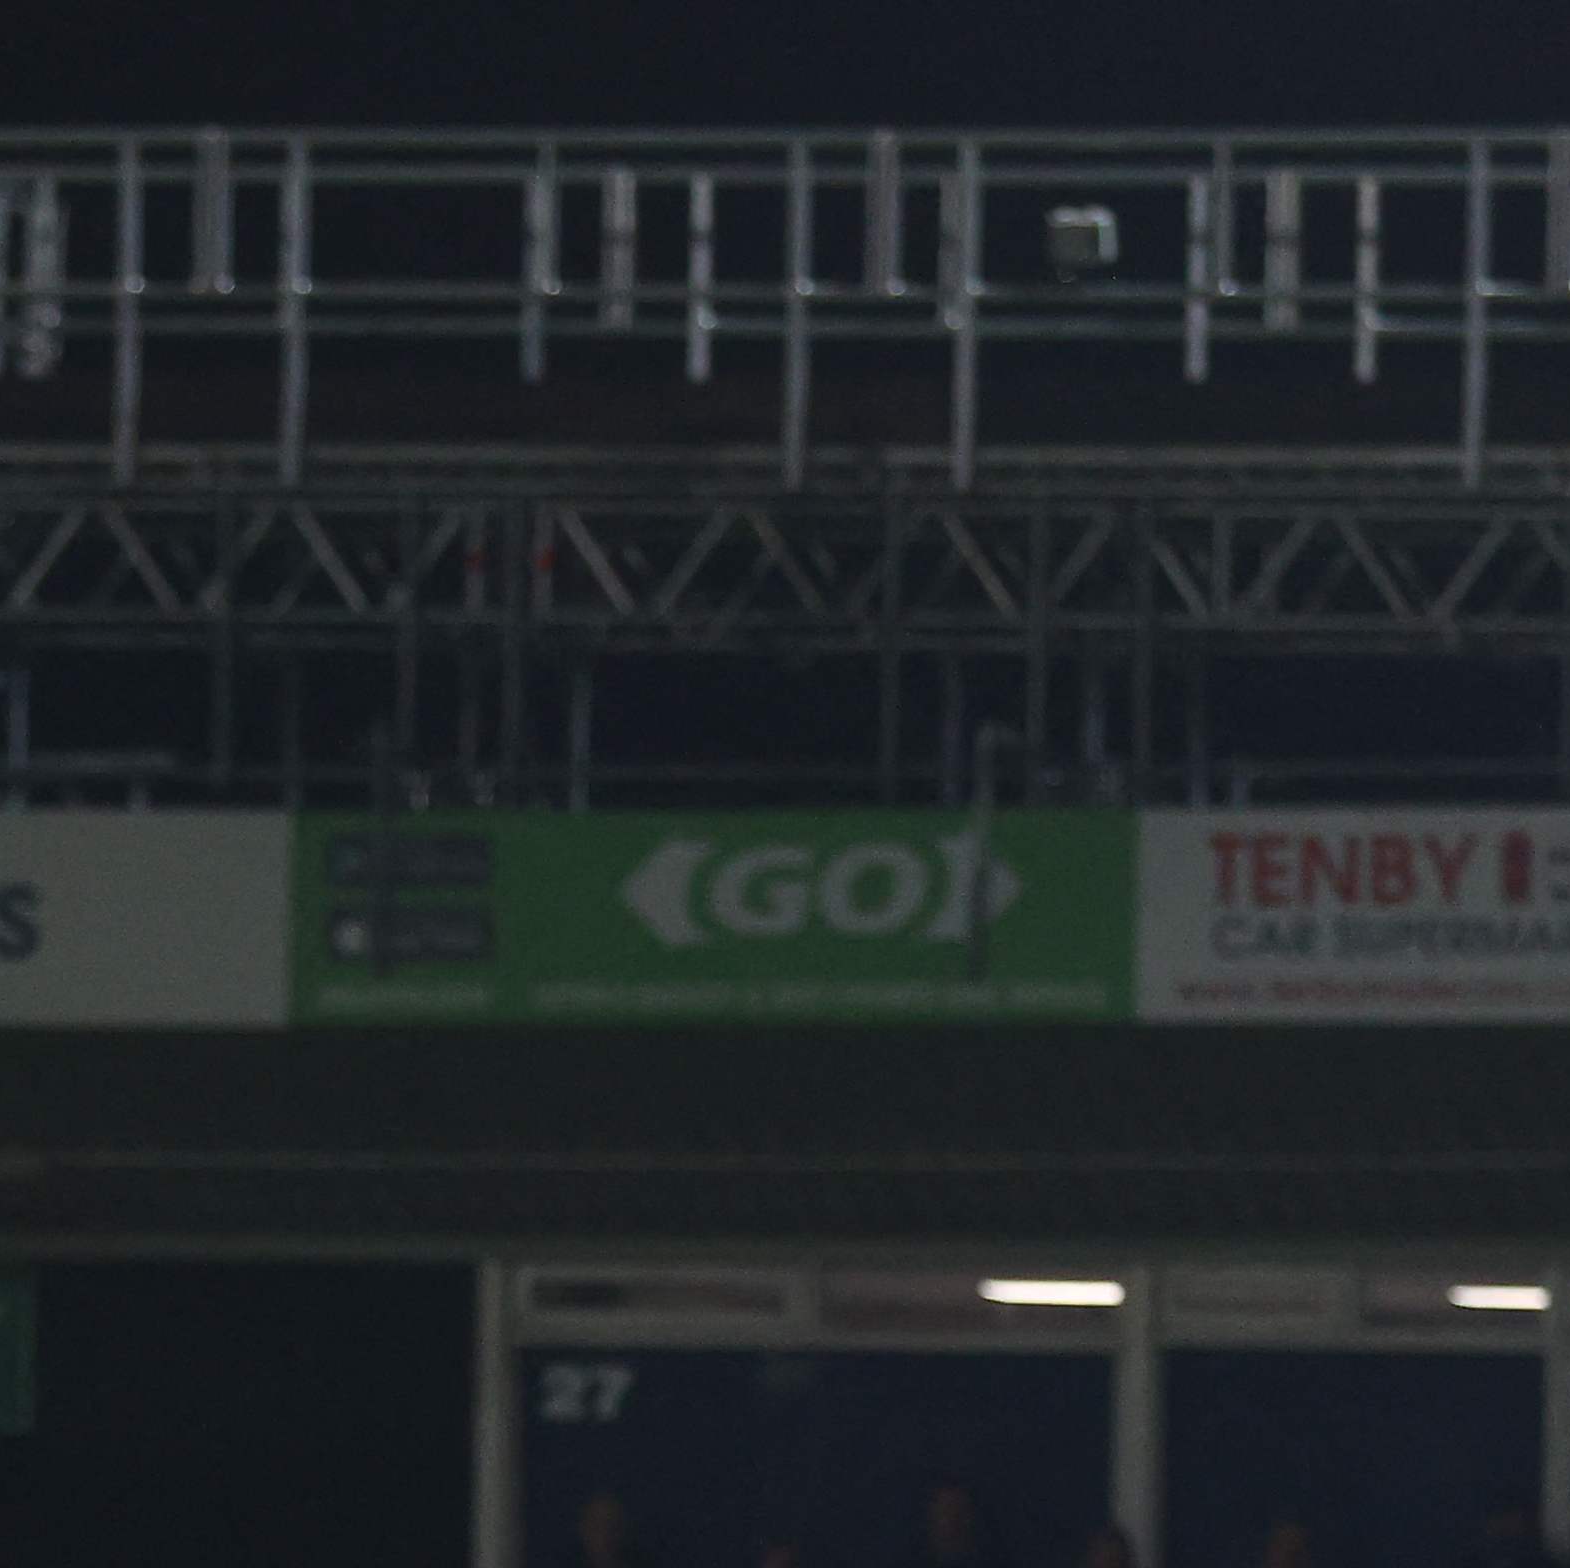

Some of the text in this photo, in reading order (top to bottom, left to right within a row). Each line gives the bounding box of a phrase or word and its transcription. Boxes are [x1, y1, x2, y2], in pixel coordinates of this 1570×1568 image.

[1209, 832, 1479, 907] TENBY
[1210, 916, 1315, 961] CAR
[541, 1362, 633, 1416] 27
